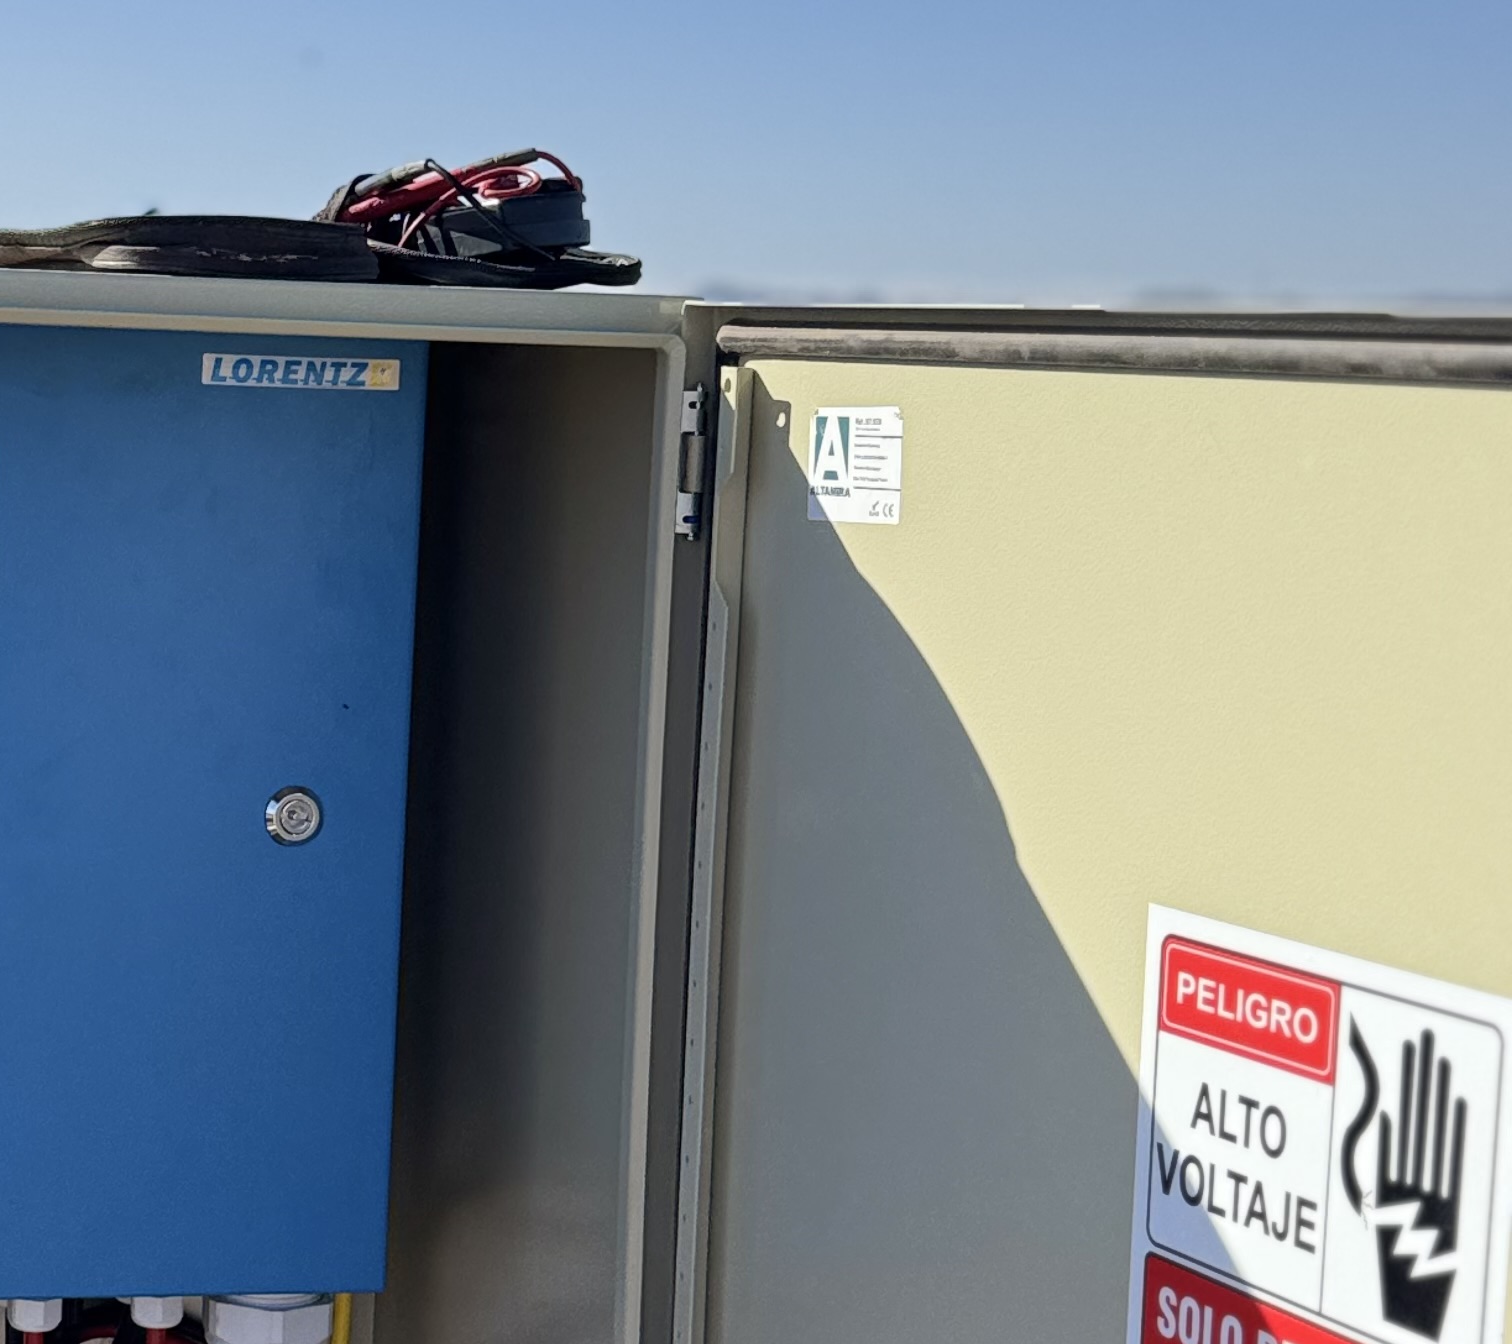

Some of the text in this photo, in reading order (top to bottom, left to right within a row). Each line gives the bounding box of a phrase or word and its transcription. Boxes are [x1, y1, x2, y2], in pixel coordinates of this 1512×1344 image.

[211, 357, 369, 387] LORENTZ
[1176, 971, 1319, 1044] PELIGRO
[1190, 1082, 1287, 1159] ALTO
[1156, 1142, 1318, 1255] VOLTAJE
